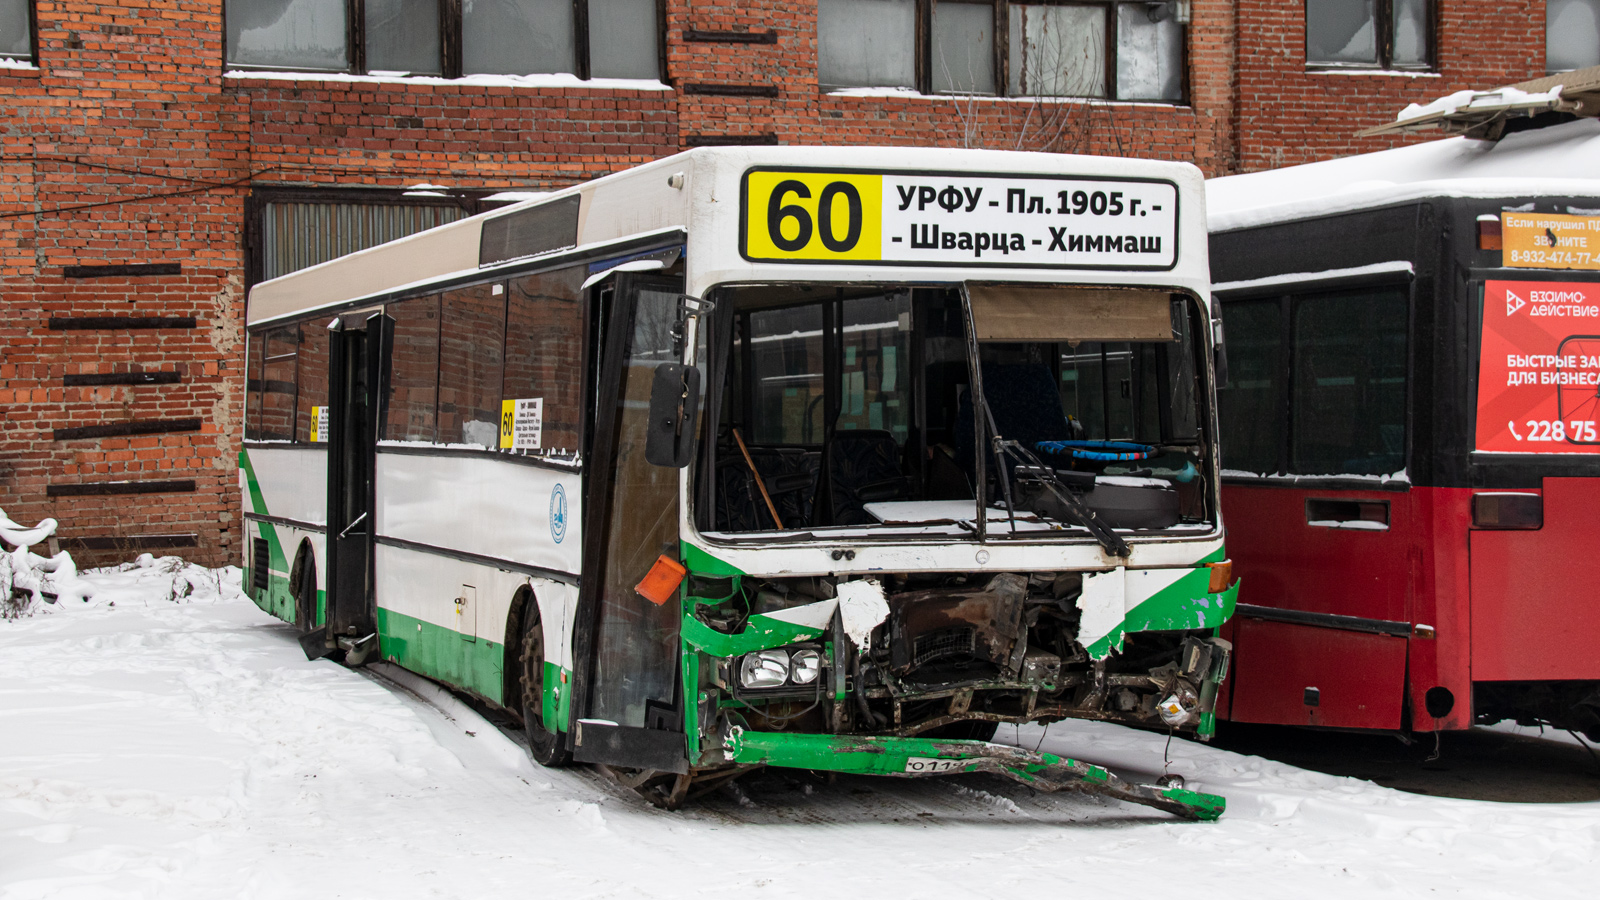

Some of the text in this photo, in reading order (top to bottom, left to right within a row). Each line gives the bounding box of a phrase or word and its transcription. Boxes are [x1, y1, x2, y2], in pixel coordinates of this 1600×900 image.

[896, 185, 983, 212] УРФУ
[1057, 190, 1124, 216] 1905
[1129, 198, 1147, 217] г.
[767, 180, 863, 252] 60
[1506, 216, 1534, 228] Если
[1536, 220, 1585, 232] нарушил
[910, 223, 1026, 258] Шварца
[1047, 226, 1162, 254] Химмаш
[1533, 235, 1588, 248] ЗВНИТЕ
[1507, 354, 1577, 369] БЫСТРЫЕ
[1506, 371, 1537, 387] ДЛЯ
[503, 411, 514, 437] 60
[1525, 419, 1597, 442] 228 75
